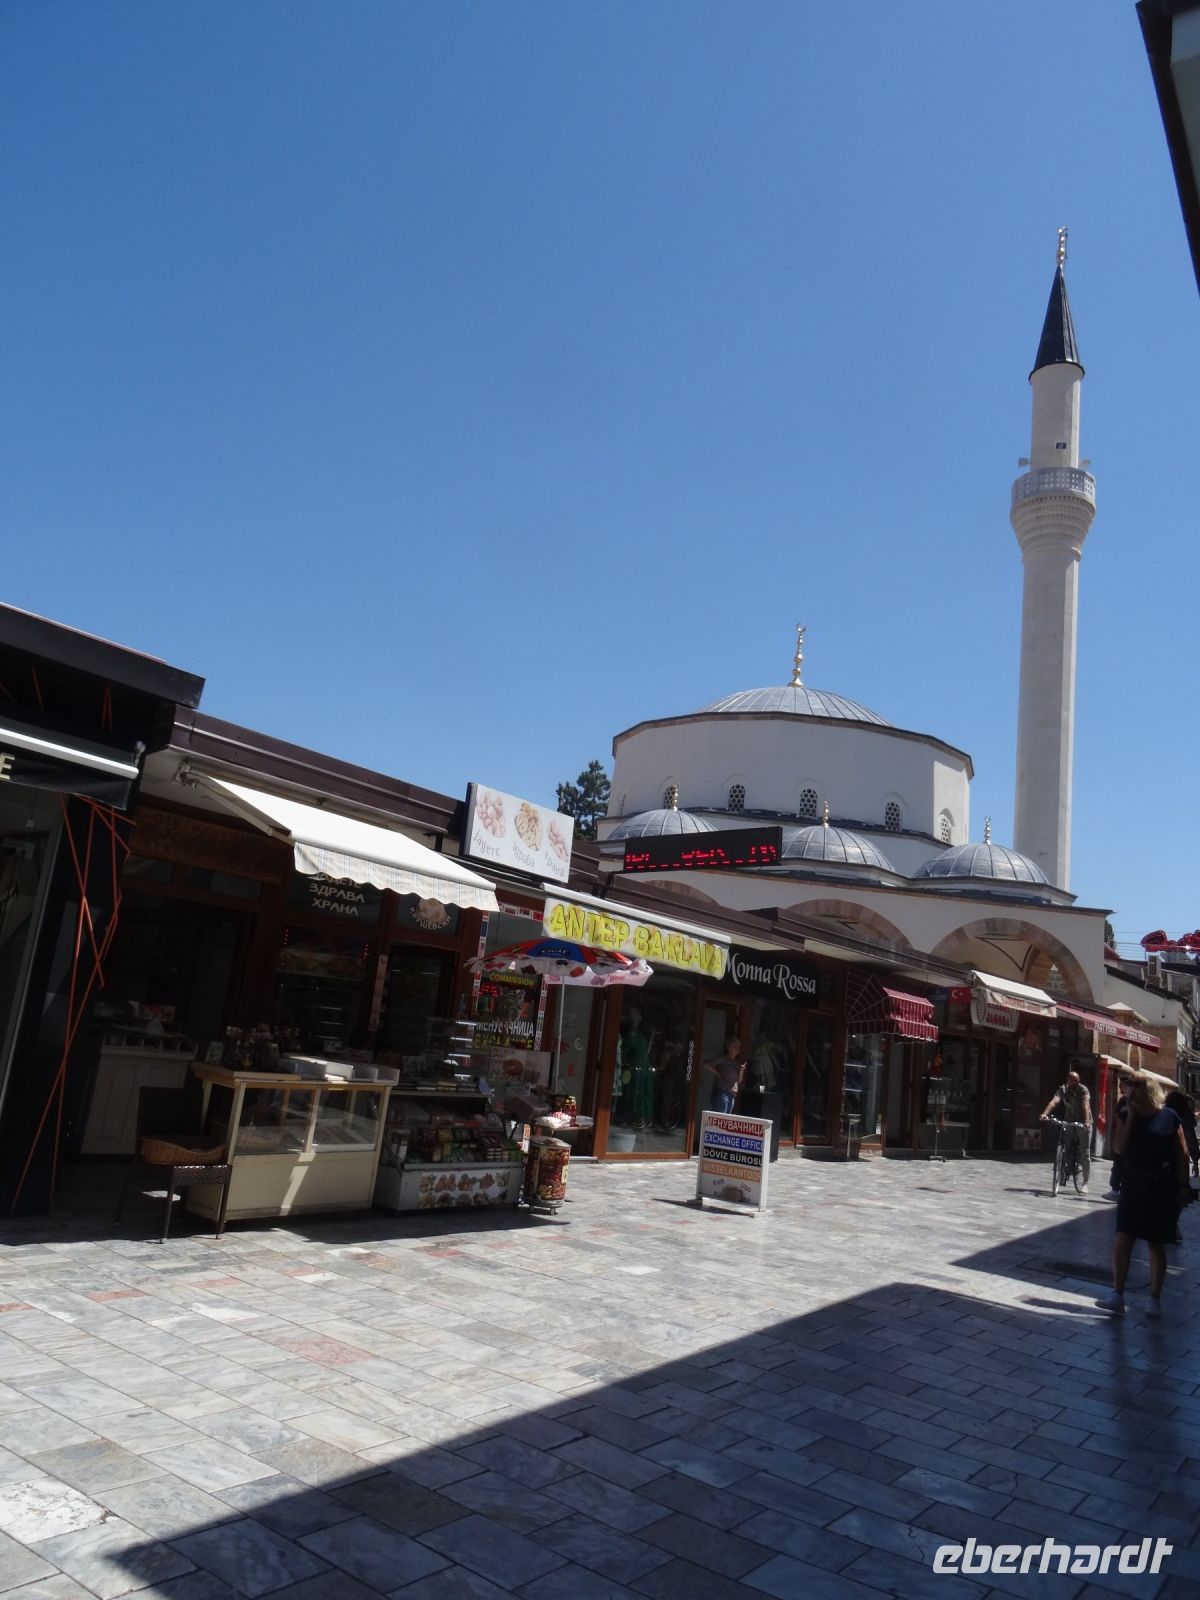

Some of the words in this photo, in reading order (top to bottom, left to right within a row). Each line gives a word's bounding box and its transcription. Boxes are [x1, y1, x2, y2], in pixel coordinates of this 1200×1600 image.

[309, 882, 365, 904] ЗДРАВА
[312, 898, 358, 916] ХРАНА
[550, 903, 631, 949] ANTEP
[633, 925, 724, 976] BAKLAVA
[489, 973, 534, 987] COMMISSION
[727, 952, 772, 985] Monna
[773, 963, 816, 1000] Rossa
[704, 1132, 741, 1148] EXCHANGE
[741, 1140, 764, 1152] OFFIC
